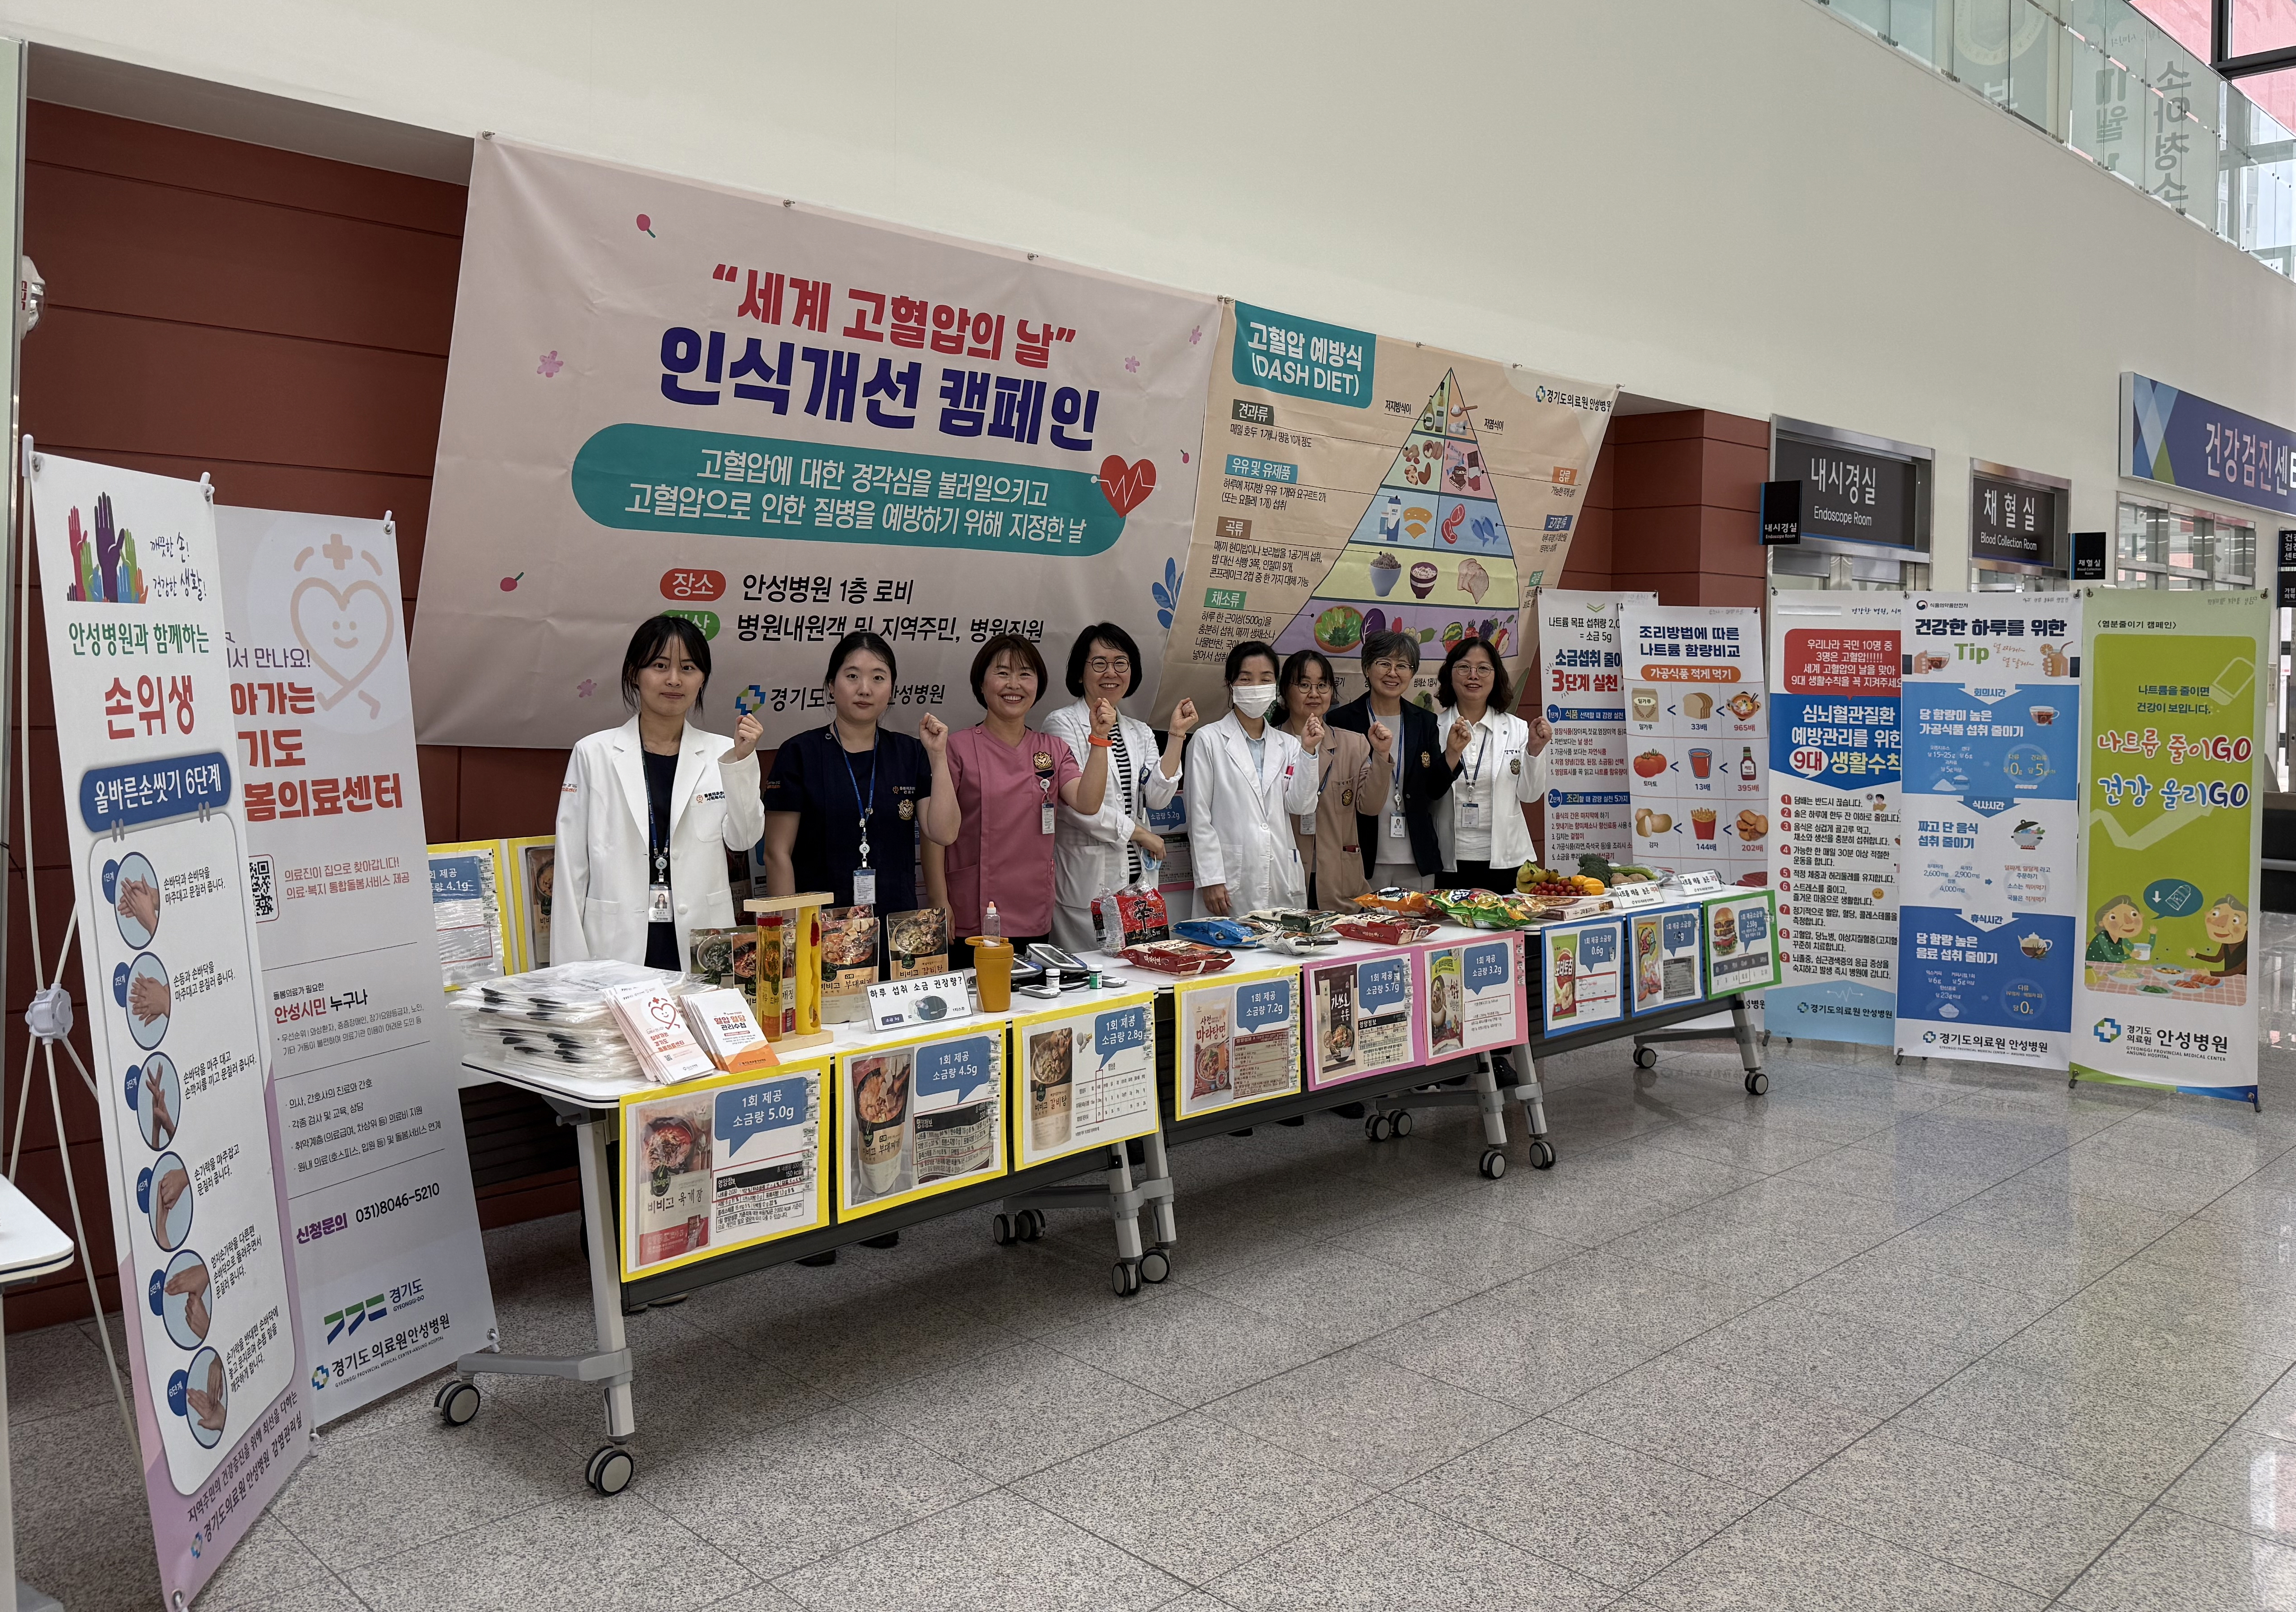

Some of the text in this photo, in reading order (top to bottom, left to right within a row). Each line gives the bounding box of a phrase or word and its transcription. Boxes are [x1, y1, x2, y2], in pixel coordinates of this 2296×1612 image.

[842, 288, 1005, 361] 고혈압의
[1247, 321, 1362, 372] 고혈압 예방식
[1252, 352, 1359, 397] (DASH DIET)
[661, 327, 1100, 452] 인식개선 캠페인
[1547, 389, 1588, 410] 경기도의료원
[1238, 402, 1268, 422] 견과류
[1385, 399, 1411, 415] 저지방식이
[1483, 418, 1504, 432] 저염식이
[696, 449, 1049, 507] 고혈압에 대한 경각심을 불러일으키고
[1231, 458, 1291, 481] 우유 및 유제품
[1811, 458, 1876, 505] 내시경실
[625, 483, 1087, 543] 고혈압으로 인한 질병을 예방하기 위해 지정한 날
[1814, 505, 1872, 526] Endoscope Room
[1225, 520, 1244, 536] 곡류
[1764, 522, 1797, 533] 내시경실
[149, 532, 189, 562] 깨끗한 손!
[1213, 540, 1322, 563] 매끼 현미밥이나 보리밥을 1공기씩 섭취,
[1980, 531, 2037, 551] Blood Collection Room
[2078, 559, 2101, 567] 채혈실
[672, 573, 714, 596] 장소
[743, 574, 914, 605] 안성병원 1층 로비
[1211, 591, 1240, 608] 채소류
[738, 614, 847, 644] 병원내원객
[880, 616, 960, 643] 지역주민,
[970, 618, 1044, 645] 병원직원
[1639, 626, 1739, 640] 조리방법에 따른
[1915, 618, 2067, 637] 건강한 하루를 위한
[69, 622, 209, 657] 안성병원과 함께하는
[1807, 639, 1892, 651] 우리나라 국민 10명 중
[254, 648, 310, 668] 만나요!
[1555, 649, 1601, 667] 소금섭취
[1640, 643, 1740, 658] 나트륨 함량비교
[1954, 643, 1989, 664] Tip
[1552, 671, 1618, 692] 3단계 실천
[1650, 667, 1731, 680] 가공식품 적게 먹기
[232, 682, 315, 716] 아가는
[1973, 688, 2007, 697] 회의시간
[2138, 685, 2209, 697] 나트륨을 줄이면
[105, 675, 195, 740] 손위생
[1802, 704, 1895, 725] 심뇌혈관질환
[2137, 702, 2211, 715] 건강이 보입니다.
[1690, 723, 1708, 731] 33배
[1733, 724, 1755, 732] 965배
[1919, 723, 2023, 738] 가공식품 섭취 줄이기
[238, 729, 306, 768] 기도
[2097, 728, 2161, 758] 나트륨
[1793, 751, 1822, 771] 9대
[94, 763, 221, 814] 올바른손씻기 6단계
[1694, 783, 1711, 791] 13배
[1737, 784, 1759, 792] 395배
[2097, 773, 2153, 806] 건강
[1696, 843, 1716, 851] 144배
[1741, 844, 1763, 852] 202배
[163, 866, 210, 891] 손바닥과 손바닥을
[284, 857, 399, 882] 의료진이 집으로 찾아갑니다!
[165, 880, 226, 905] 마주대고 문질러 줍니다.
[286, 871, 410, 900] 의료·복지 통합돌봄서비스 제공
[1133, 899, 1155, 933] 辛
[921, 964, 944, 976] 갈비탕
[1472, 964, 1502, 976] 소금량 3.2g
[869, 975, 964, 998] 하루 섭취 소금 권장량?
[274, 988, 368, 1024] 안성시민 누구나
[1246, 1003, 1283, 1016] 소금량 7.2g
[1810, 1004, 1892, 1019] 경기도의료원 안성병원
[1196, 1023, 1225, 1042] 마라탕면
[2126, 1034, 2151, 1046] 의료원
[2127, 1025, 2152, 1035] 경기도
[1939, 1033, 2048, 1053] 경기도의료원 안성병원
[2156, 1029, 2227, 1054] 안성병원
[933, 1064, 977, 1081] 소금량 4.5g
[742, 1089, 783, 1108] 1회 제공
[733, 1105, 794, 1127] 소금량 5.0g
[355, 1182, 440, 1223] 031)8046-5210
[678, 1187, 703, 1204] 육개장
[296, 1212, 348, 1244] 신청문의
[332, 1313, 451, 1377] 경기도의료원 안성병원
